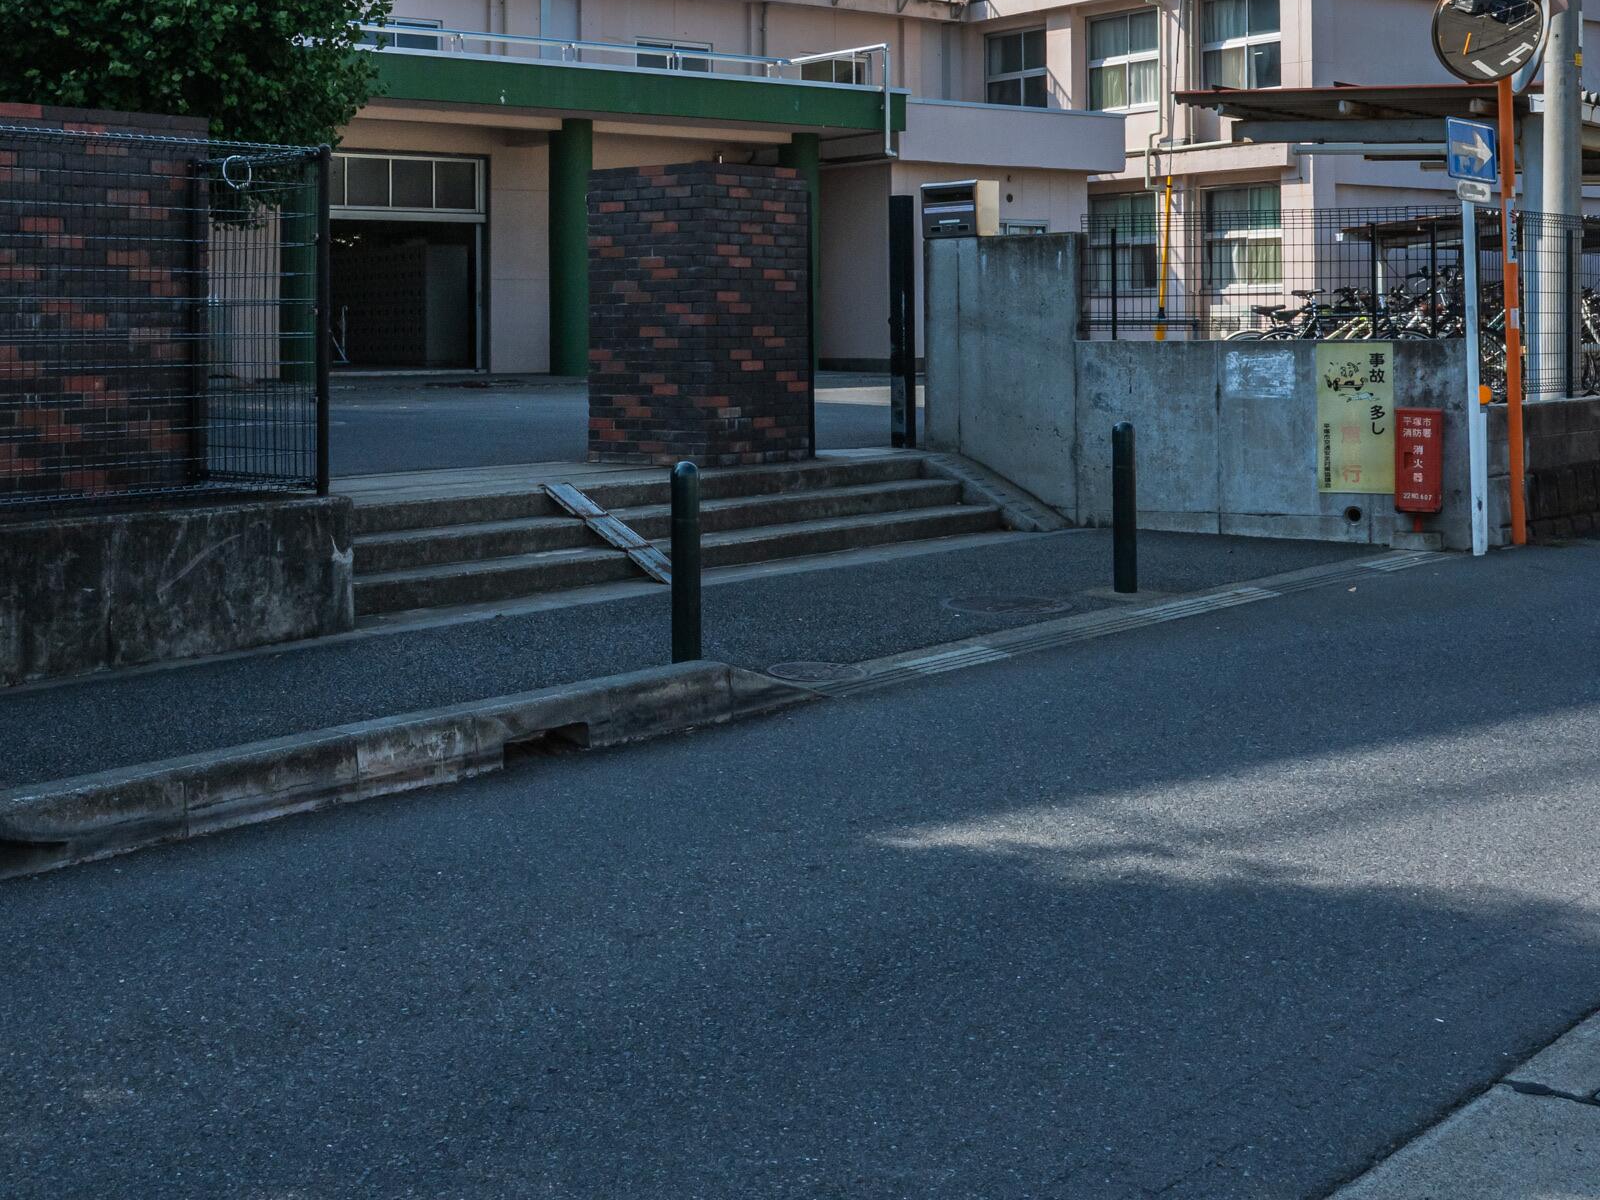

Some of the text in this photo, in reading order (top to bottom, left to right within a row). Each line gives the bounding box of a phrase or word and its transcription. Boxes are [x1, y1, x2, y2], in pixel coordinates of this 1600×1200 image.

[1403, 416, 1432, 427] 平塚市
[1403, 428, 1432, 438] 消防署
[1413, 445, 1424, 483] 消火器
